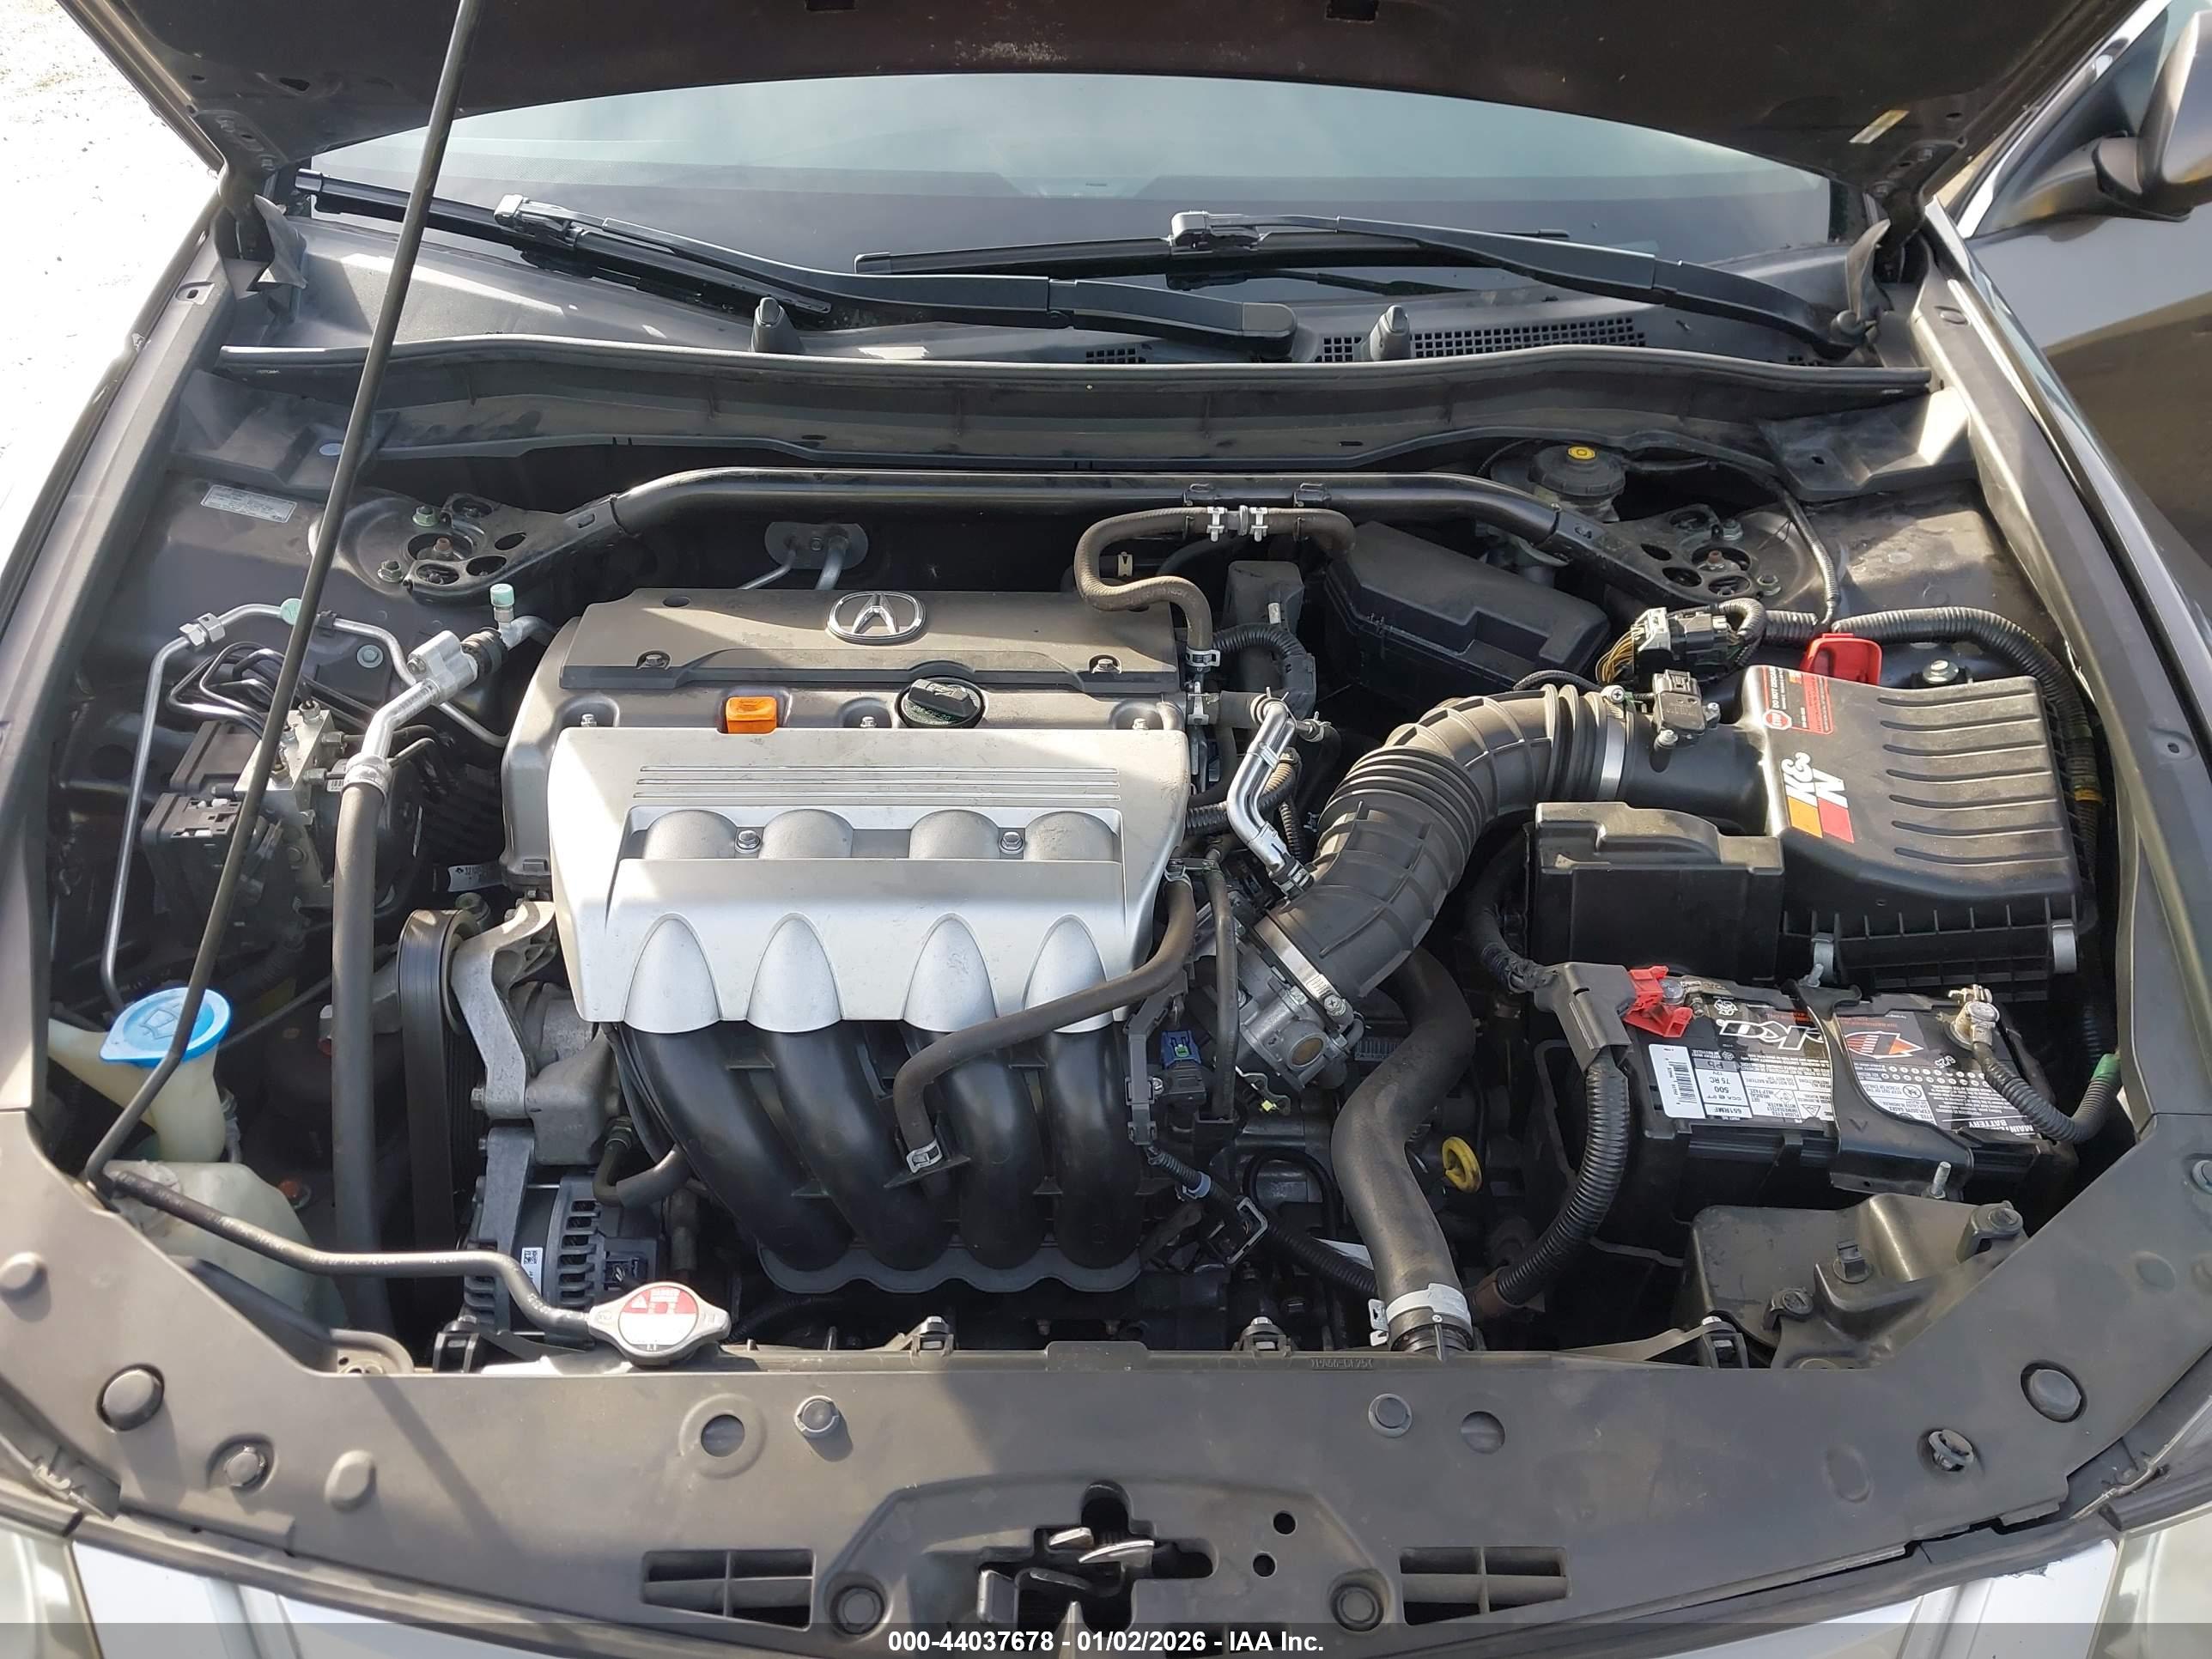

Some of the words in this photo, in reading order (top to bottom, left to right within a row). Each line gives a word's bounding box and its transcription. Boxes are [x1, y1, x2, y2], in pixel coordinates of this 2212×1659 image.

[1780, 751, 1849, 809] K&N
[1707, 1060, 1723, 1070] Pb
[1935, 1055, 1956, 1068] 6/25
[1714, 1085, 1729, 1094] 500
[1968, 1119, 2008, 1128] BATTERY
